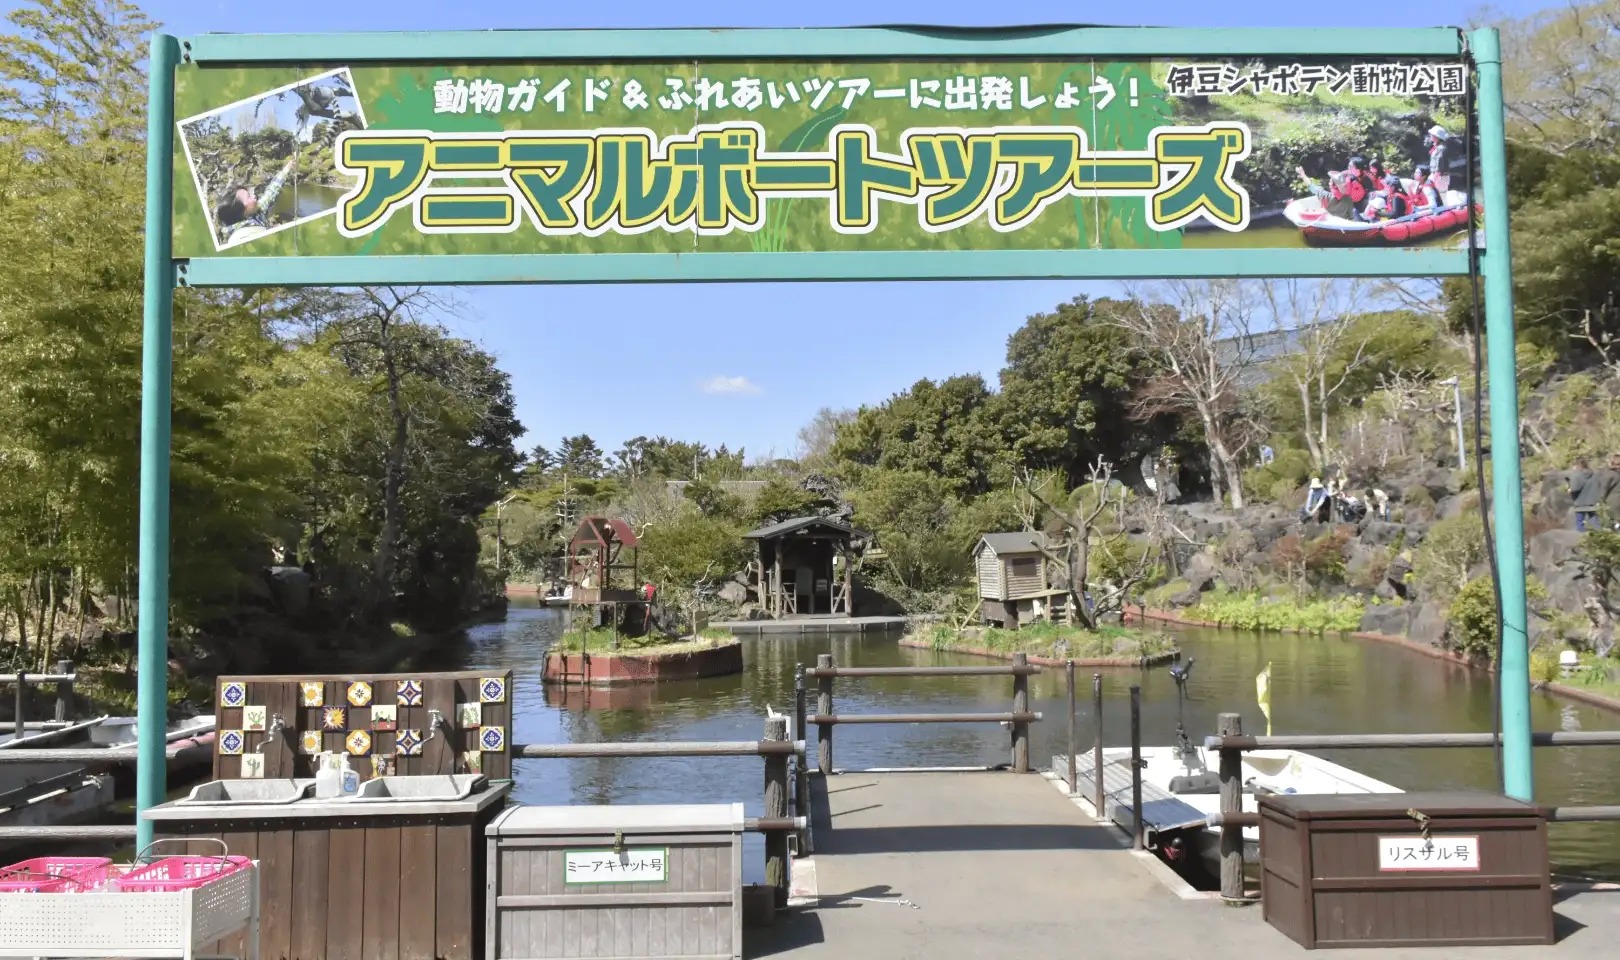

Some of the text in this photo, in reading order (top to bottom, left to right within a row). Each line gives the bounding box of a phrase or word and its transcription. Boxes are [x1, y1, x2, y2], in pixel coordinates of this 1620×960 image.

[336, 122, 1248, 236] アニマルボートツアーズ
[568, 858, 663, 872] ミーアキャット号
